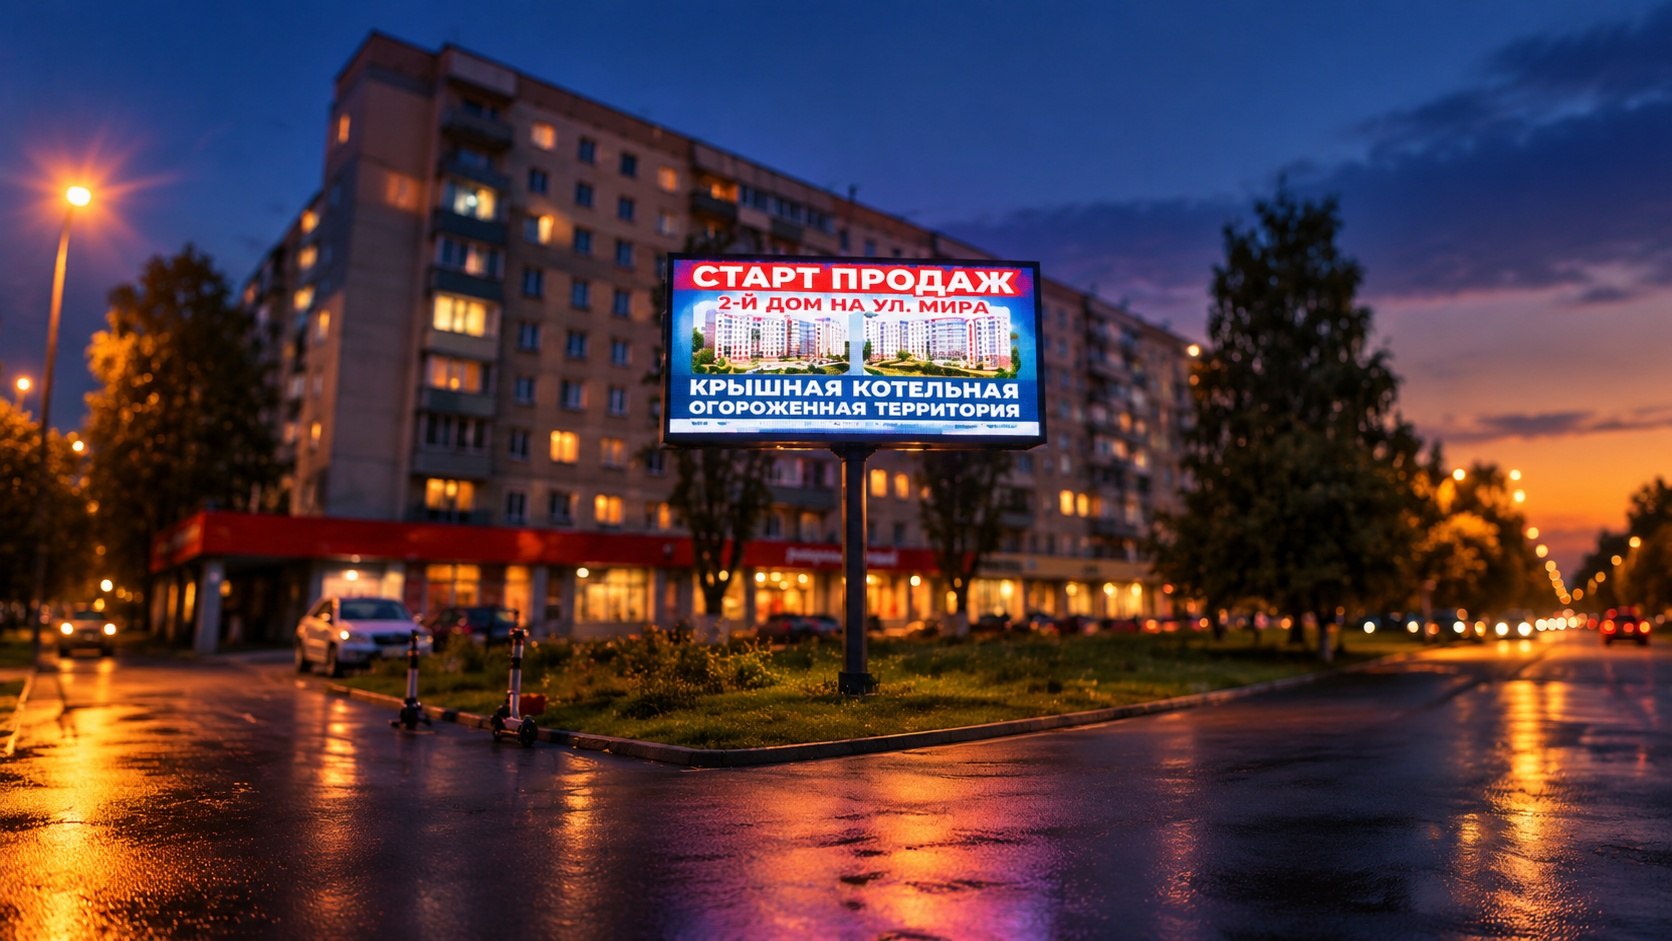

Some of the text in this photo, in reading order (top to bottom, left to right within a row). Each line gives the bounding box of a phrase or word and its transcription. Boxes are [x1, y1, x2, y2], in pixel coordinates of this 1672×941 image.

[692, 265, 1015, 296] СТАРТ ПРОДАЖ
[718, 293, 990, 314] 2-Й ДОМ НА УЛ. МИРА
[690, 379, 1019, 399] КРЫШНАЯ КОТЕЛЬНАЯ
[689, 400, 1020, 418] ОГОРОЖЕННАЯ ТЕРРИТОРИЯ
